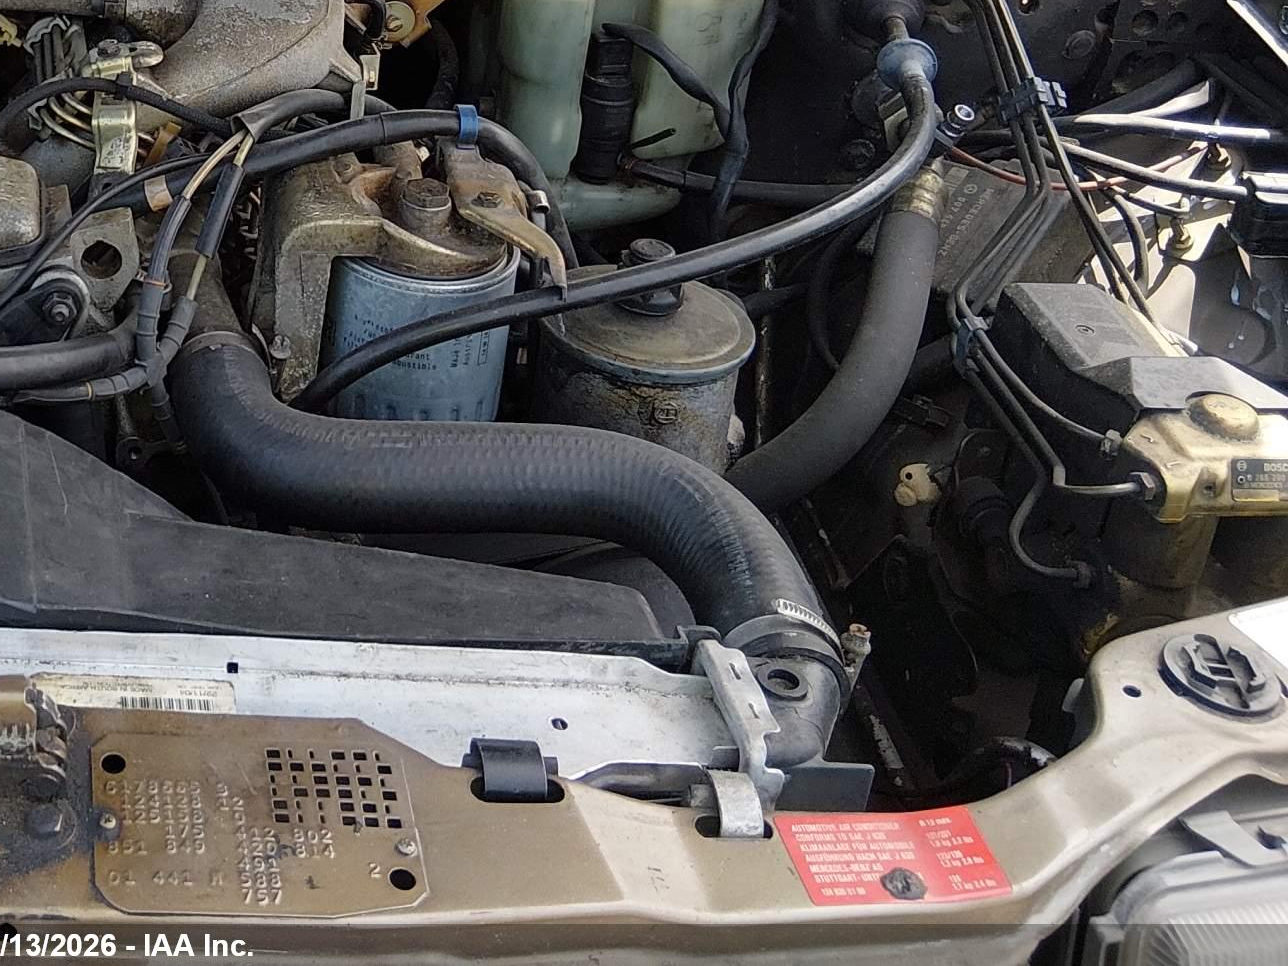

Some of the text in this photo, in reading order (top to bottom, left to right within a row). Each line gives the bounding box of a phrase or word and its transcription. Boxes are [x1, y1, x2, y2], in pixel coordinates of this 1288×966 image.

[218, 797, 245, 811] 12
[165, 825, 333, 843] 175 412 802
[792, 823, 836, 832] AUTOMOTIVE
[839, 823, 851, 831] AIR
[795, 833, 837, 841] CONFORMS
[838, 833, 848, 841] TO
[848, 832, 867, 841] SAE
[167, 840, 206, 854] 849
[237, 842, 278, 856] 420
[295, 843, 335, 859] 814
[800, 843, 852, 852] KLIMAANLAGE
[852, 841, 869, 851] FÜR
[855, 852, 876, 861] NACH
[877, 852, 892, 860] SAE
[238, 857, 280, 872] 491
[369, 862, 381, 878] 2
[809, 863, 884, 872] MERCEDES-BENZ AG
[152, 871, 192, 885] 441
[240, 873, 282, 888] 588
[242, 889, 282, 906] 757
